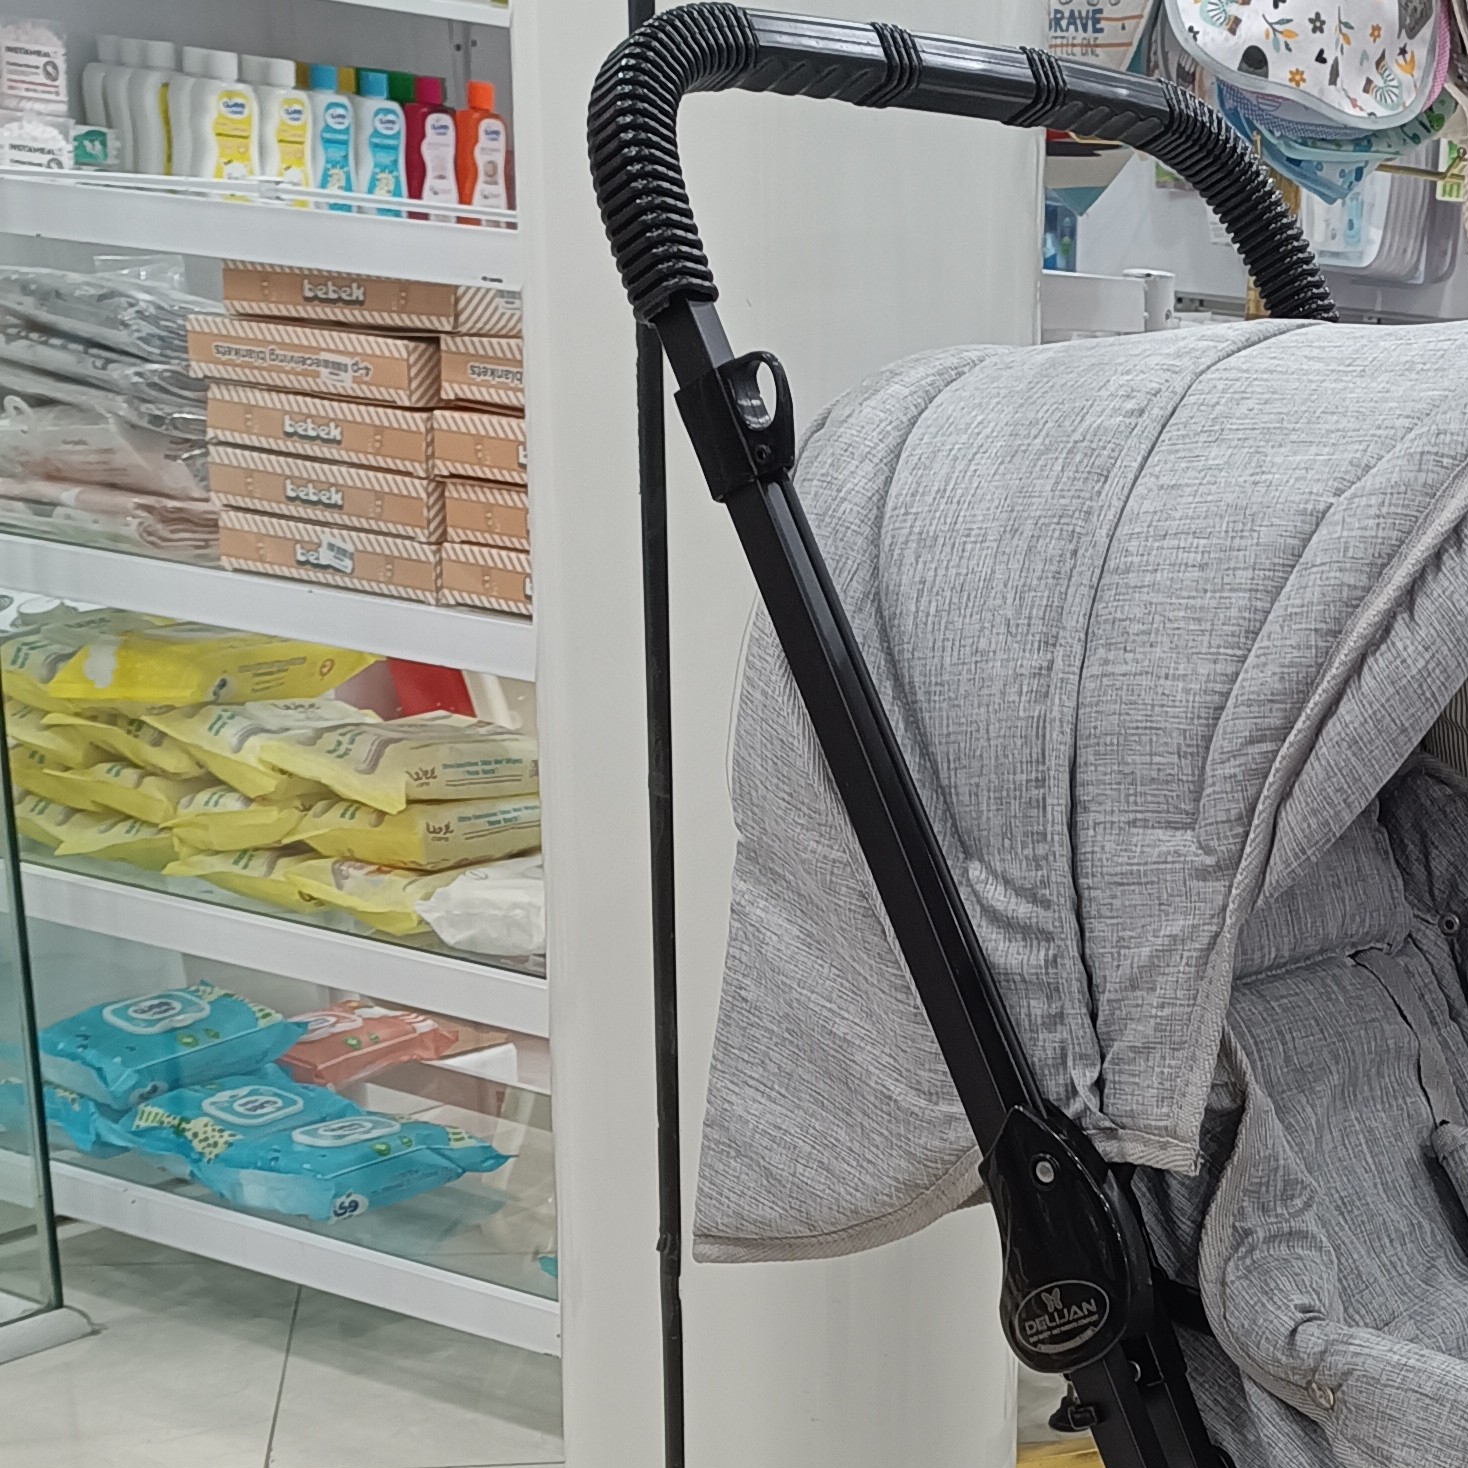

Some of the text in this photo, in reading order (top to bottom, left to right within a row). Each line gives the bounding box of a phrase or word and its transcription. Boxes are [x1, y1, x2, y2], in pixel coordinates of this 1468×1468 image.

[1049, 8, 1104, 34] RAVE
[303, 279, 365, 305] bebek
[283, 414, 342, 444] bebek
[285, 479, 343, 509] bebek
[1024, 1297, 1098, 1336] DELIJAN
